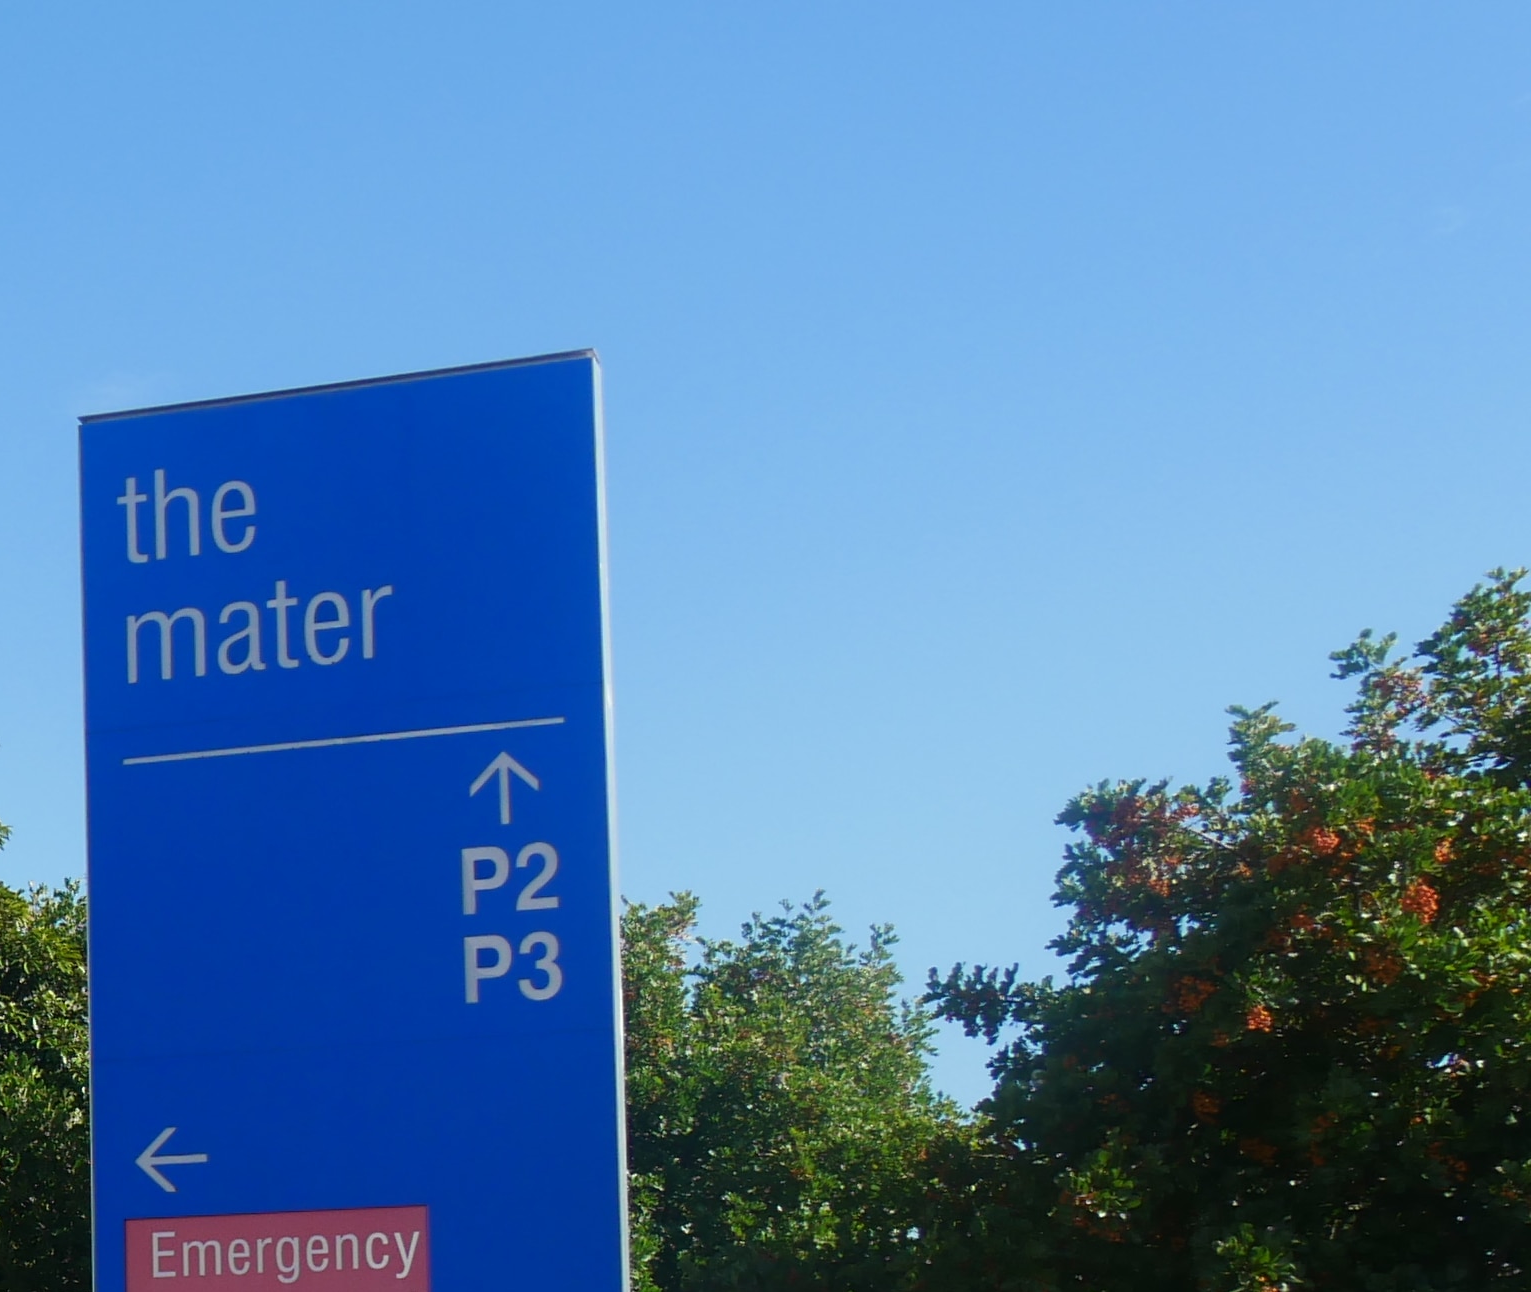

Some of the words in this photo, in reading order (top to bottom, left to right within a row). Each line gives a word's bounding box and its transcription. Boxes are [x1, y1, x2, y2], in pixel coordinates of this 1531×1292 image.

[116, 469, 257, 564] the
[125, 580, 393, 684] mater
[461, 841, 560, 915] P2
[463, 931, 563, 1004] P3
[151, 1230, 421, 1284] Emergency
